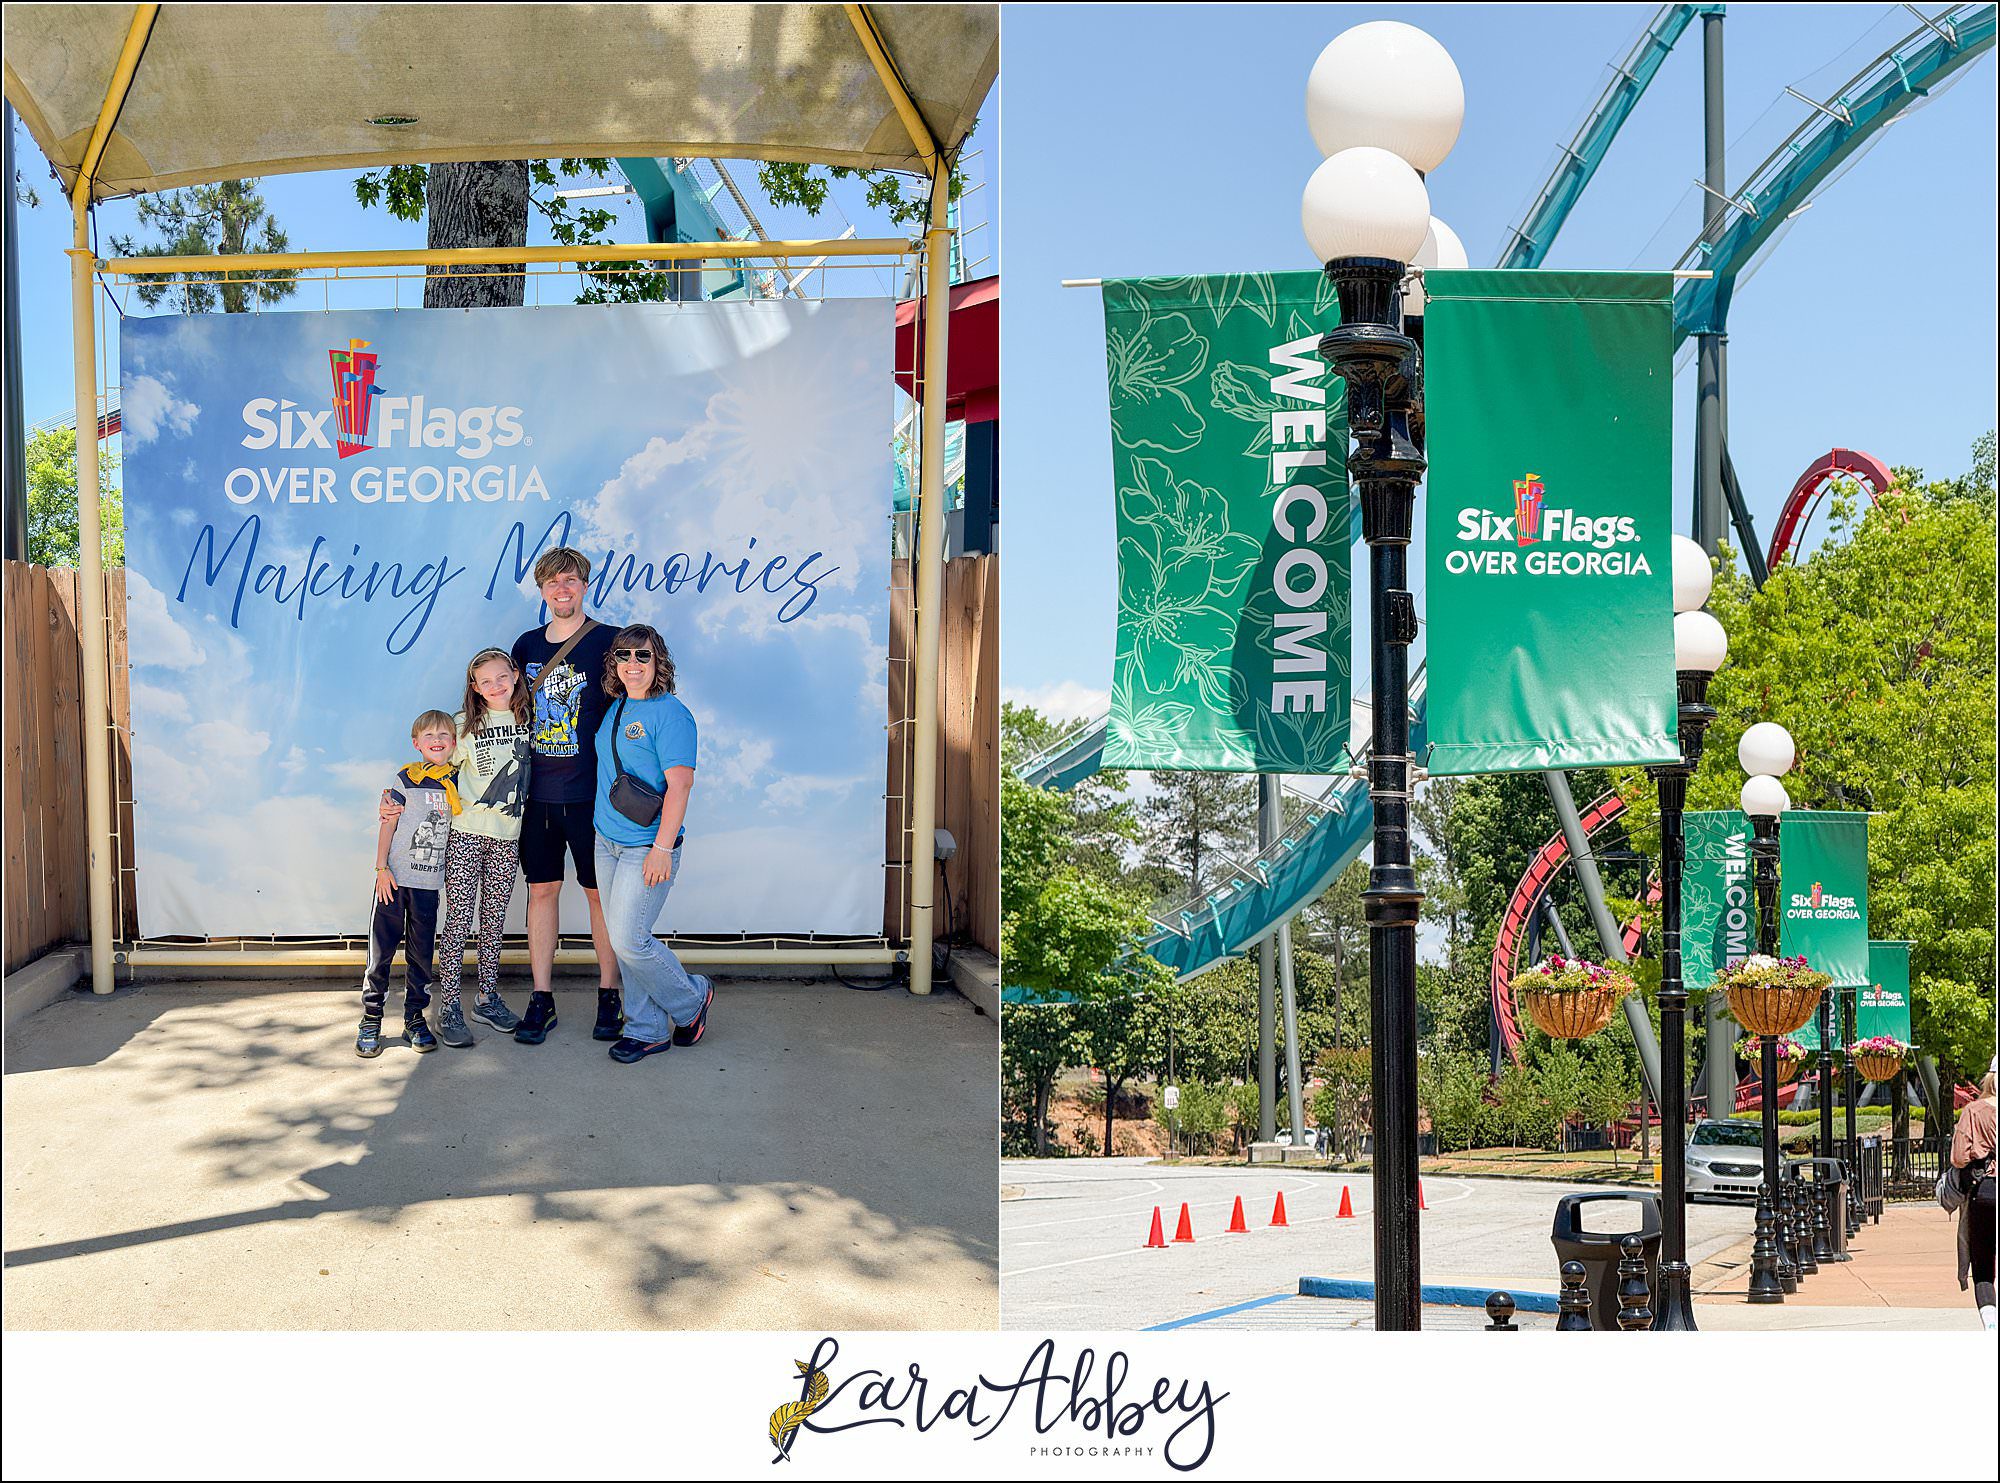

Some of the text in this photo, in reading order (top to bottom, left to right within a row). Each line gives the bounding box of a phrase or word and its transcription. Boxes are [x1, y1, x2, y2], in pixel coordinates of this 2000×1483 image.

[241, 396, 332, 450] Six
[224, 465, 550, 504] OVER GEORGIA
[1269, 332, 1328, 714] WELCOME
[1457, 508, 1515, 542] Six
[1445, 551, 1652, 576] OVER GEORGIA
[175, 510, 841, 655] Making Mmories
[544, 671, 587, 699] FASTER!
[471, 724, 529, 740] TOOTHLES
[496, 737, 513, 746] FURY
[1787, 908, 1860, 920] OVER GEORGIA
[1791, 894, 1812, 907] Six
